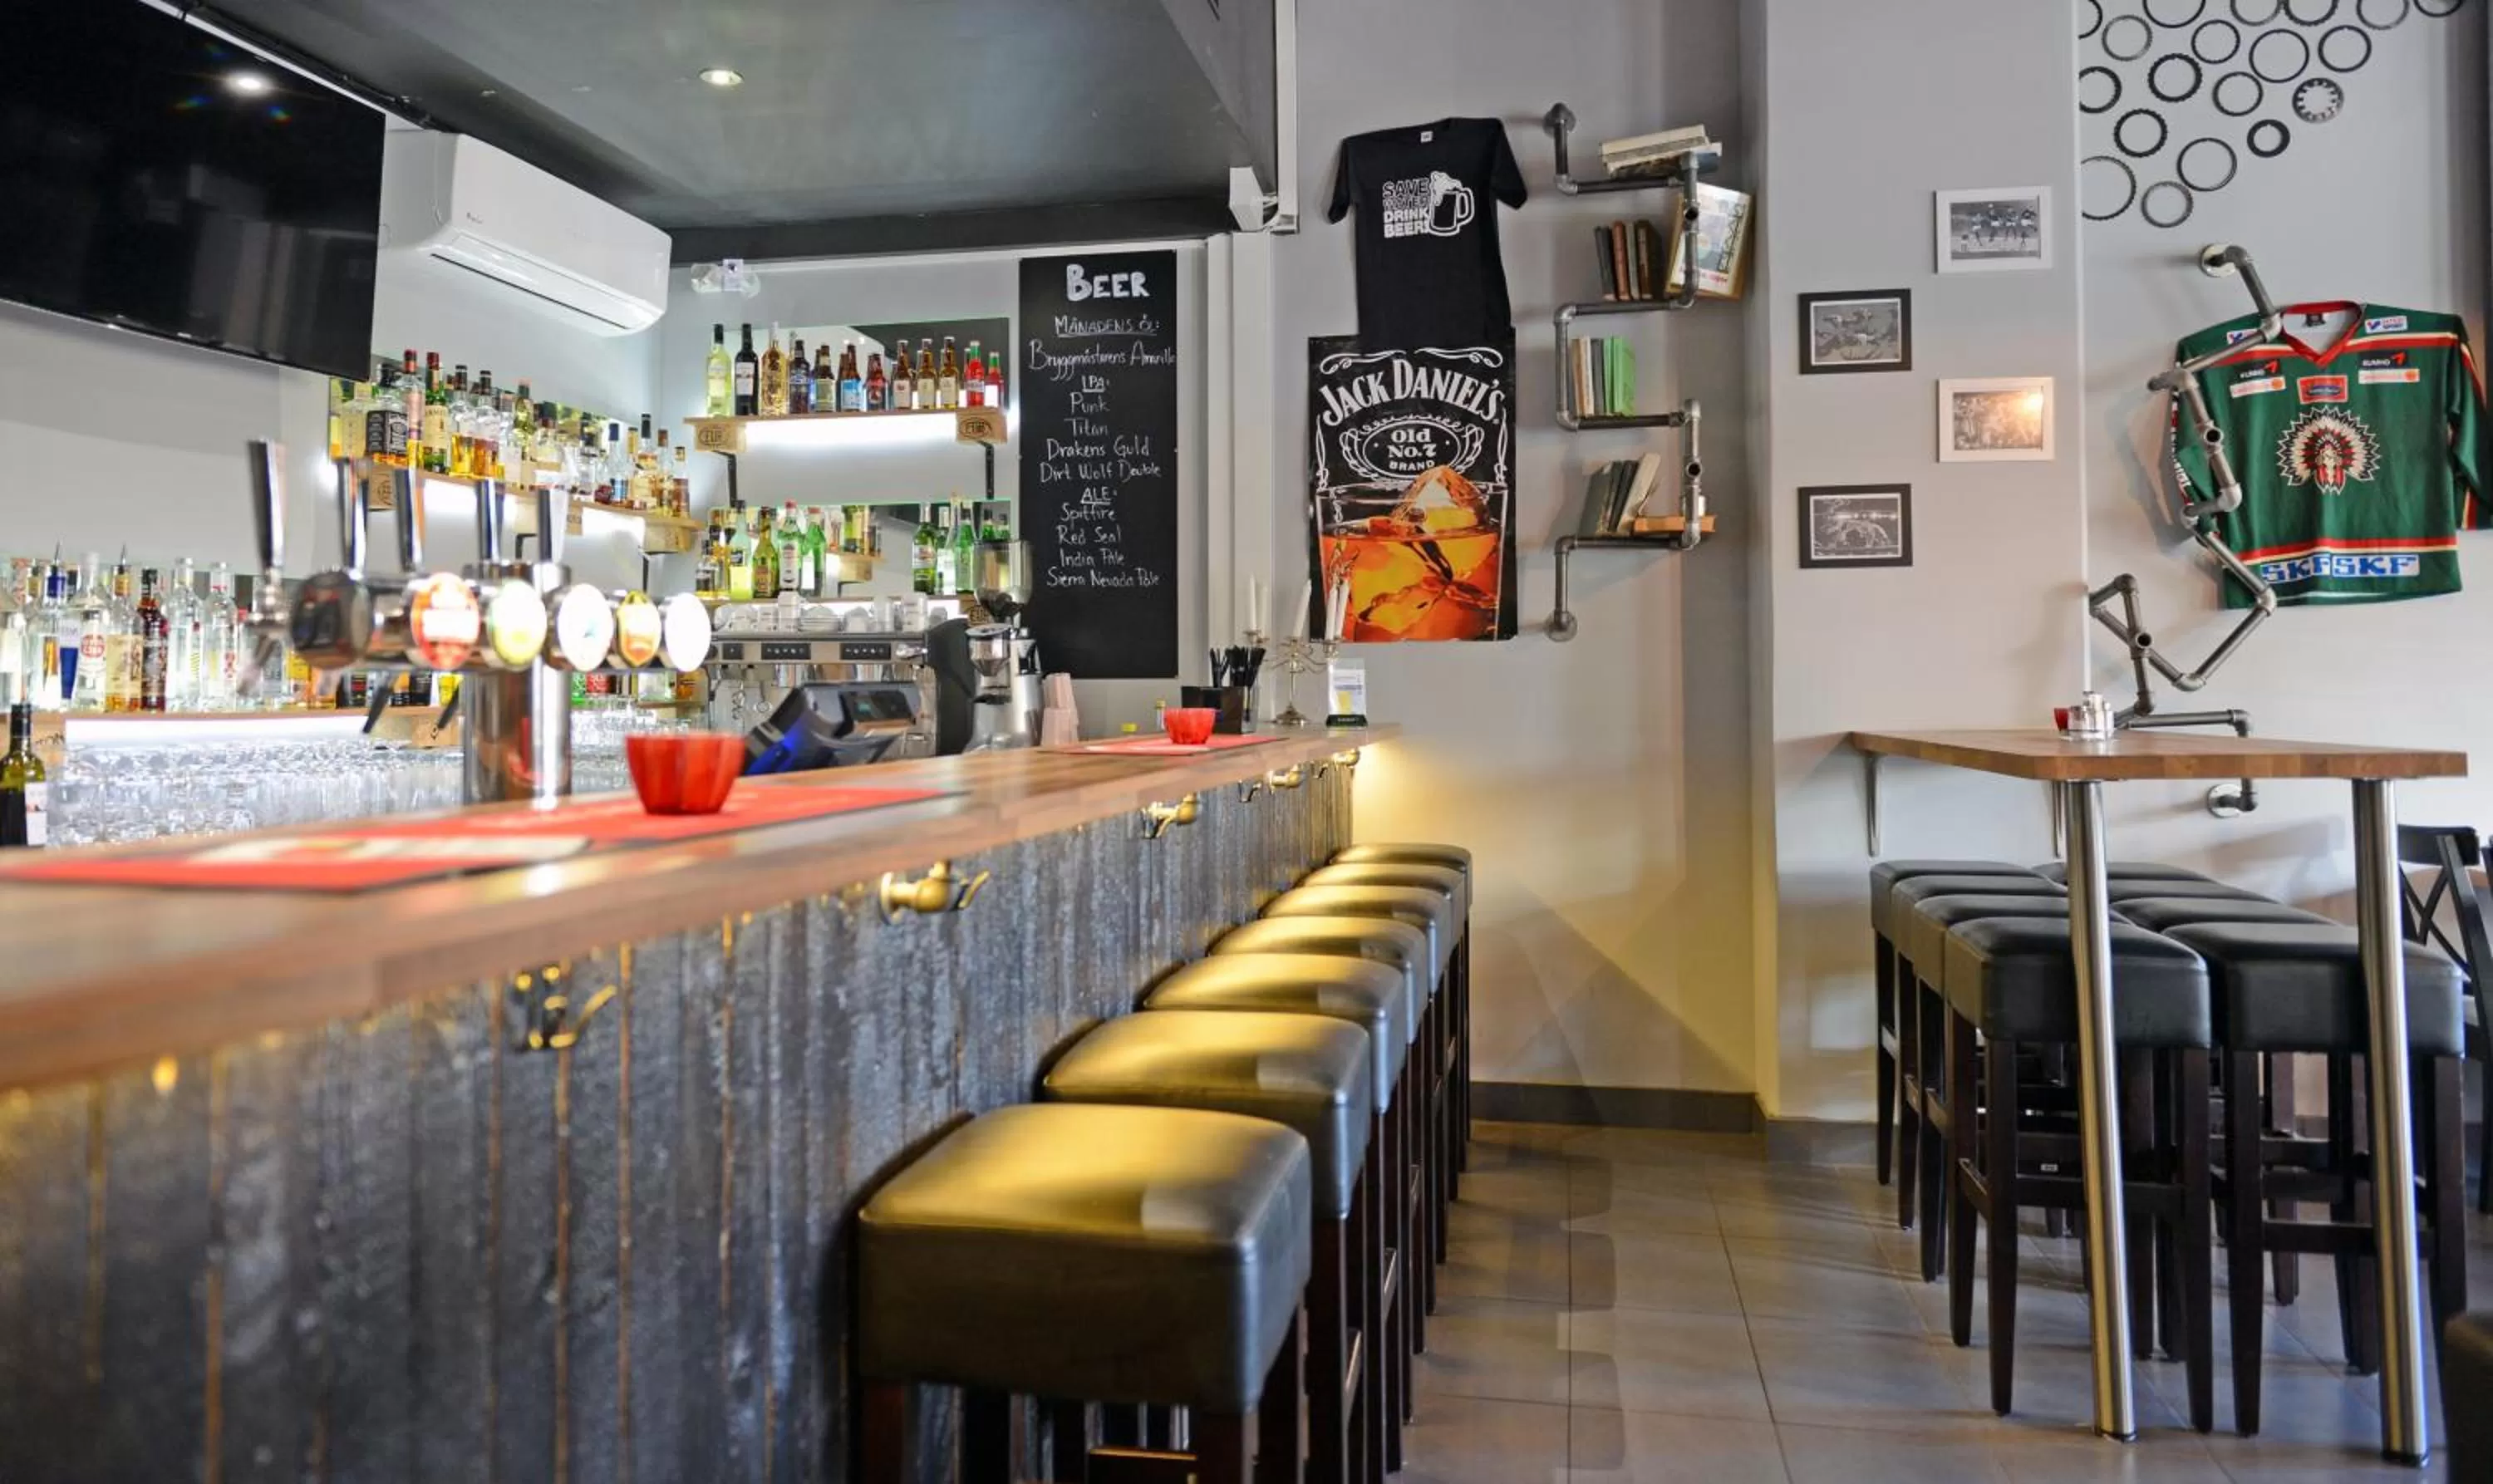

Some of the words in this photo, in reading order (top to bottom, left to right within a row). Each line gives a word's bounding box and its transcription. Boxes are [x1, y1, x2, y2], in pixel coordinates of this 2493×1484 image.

[1383, 177, 1429, 198] SAVE
[1384, 207, 1429, 223] DRINK
[1070, 391, 1110, 415] Punk
[1319, 371, 1392, 426] JACK
[1064, 417, 1108, 436] Titan
[1390, 428, 1431, 443] Old
[1046, 438, 1105, 461] Drakens
[1040, 461, 1071, 483] Dirt
[1079, 461, 1113, 479] Wolf
[1389, 459, 1435, 471] BRAND
[1056, 524, 1086, 545] Red
[1094, 523, 1122, 543] Seal
[2334, 558, 2417, 575] SKF
